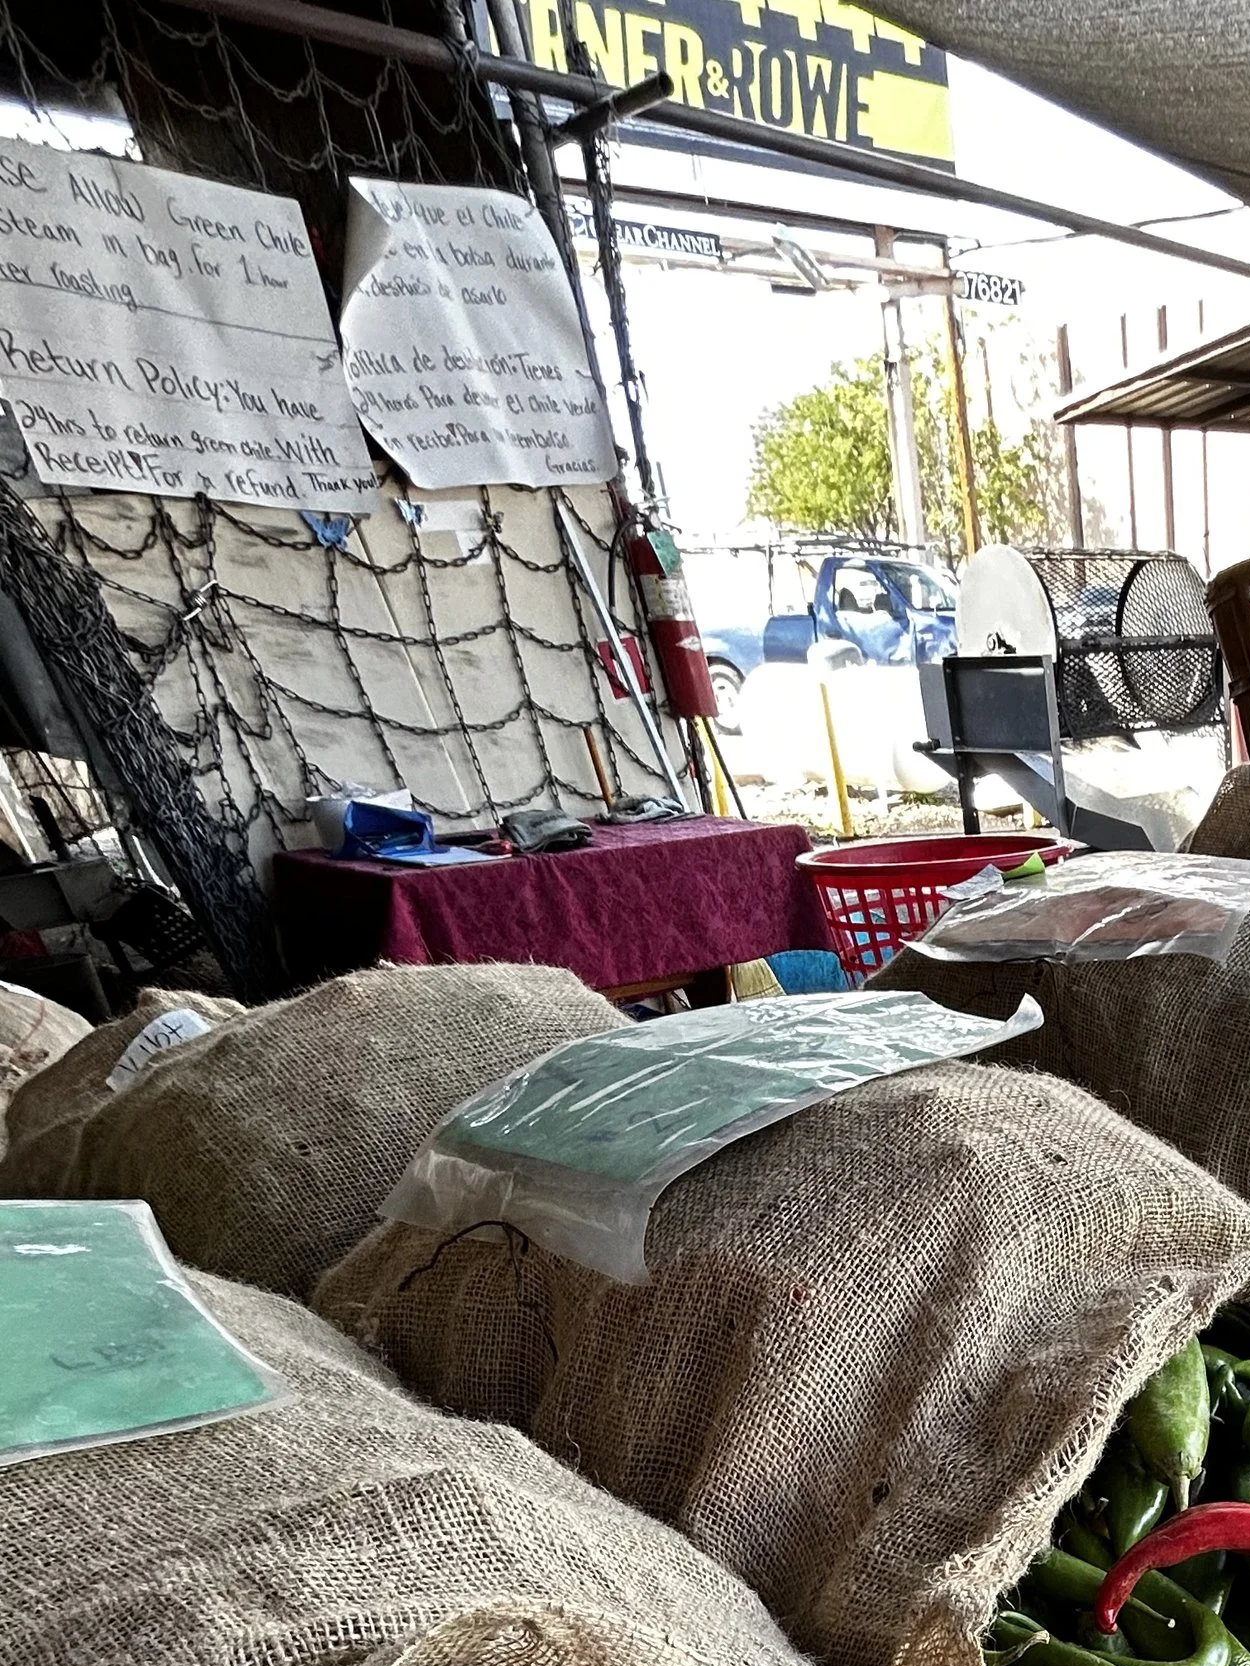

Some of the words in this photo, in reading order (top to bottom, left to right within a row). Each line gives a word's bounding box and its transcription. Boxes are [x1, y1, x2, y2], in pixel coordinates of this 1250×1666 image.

[166, 196, 246, 243] Green
[255, 220, 311, 259] Chile
[449, 241, 495, 267] bolsa
[50, 261, 137, 313] roasting
[102, 233, 128, 258] in
[239, 254, 255, 286] 1
[258, 266, 289, 290] hour
[0, 328, 134, 392] Return
[226, 380, 268, 415] You
[270, 387, 324, 421] have
[413, 345, 436, 373] de
[88, 408, 117, 441] to
[124, 422, 184, 448] return
[191, 430, 237, 455] green
[274, 433, 340, 466] With
[142, 453, 183, 488] For
[198, 471, 216, 490] a
[302, 472, 351, 493] Thank
